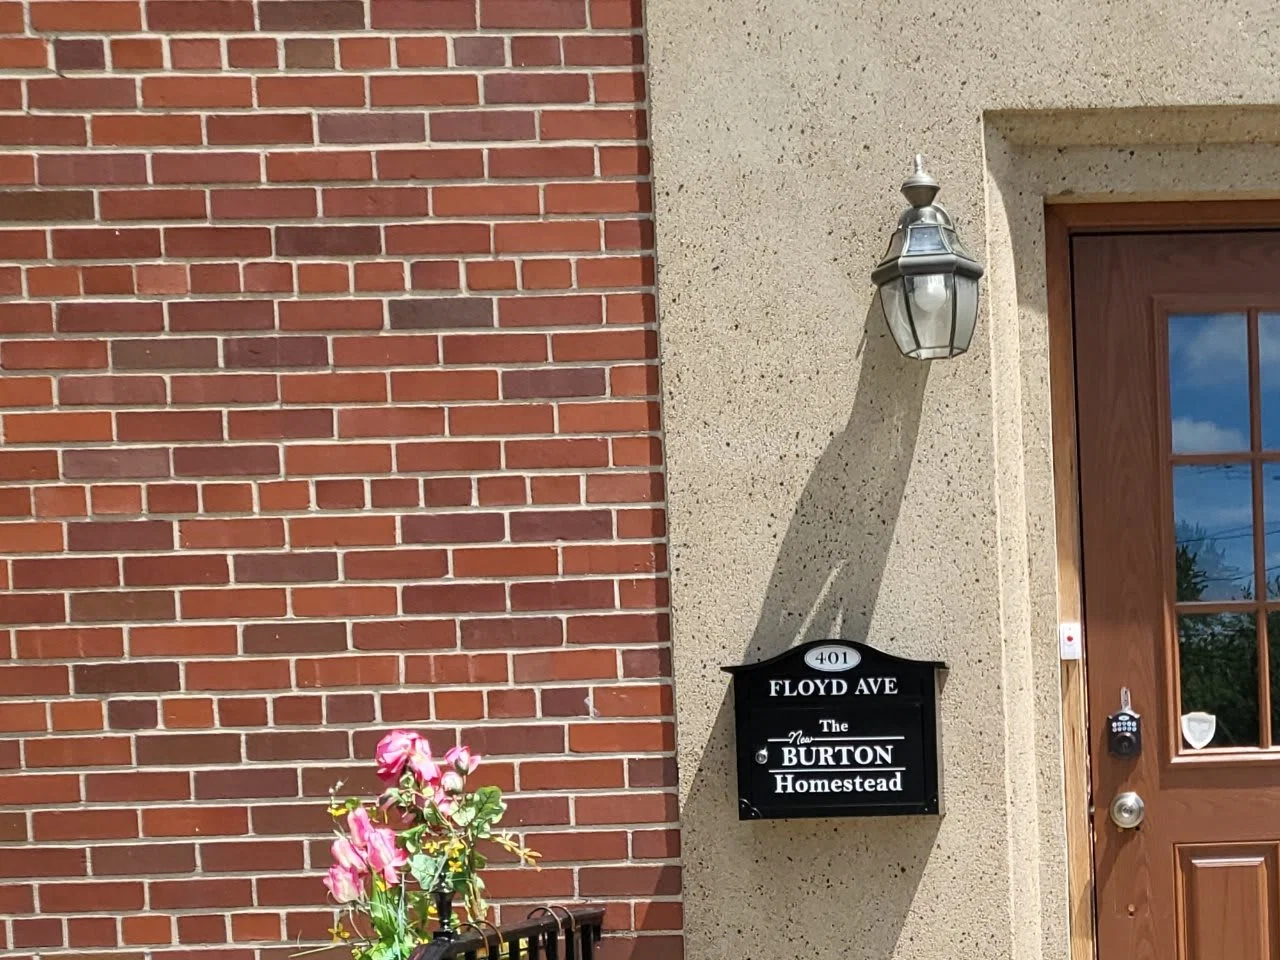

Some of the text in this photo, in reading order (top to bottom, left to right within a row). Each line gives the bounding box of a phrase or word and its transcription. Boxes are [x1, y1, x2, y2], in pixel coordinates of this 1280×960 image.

[815, 651, 849, 665] 401
[768, 677, 898, 697] FLOYD AVE
[819, 719, 849, 733] The
[788, 730, 814, 745] New
[781, 745, 894, 767] BURTON
[774, 772, 903, 794] Homestead
